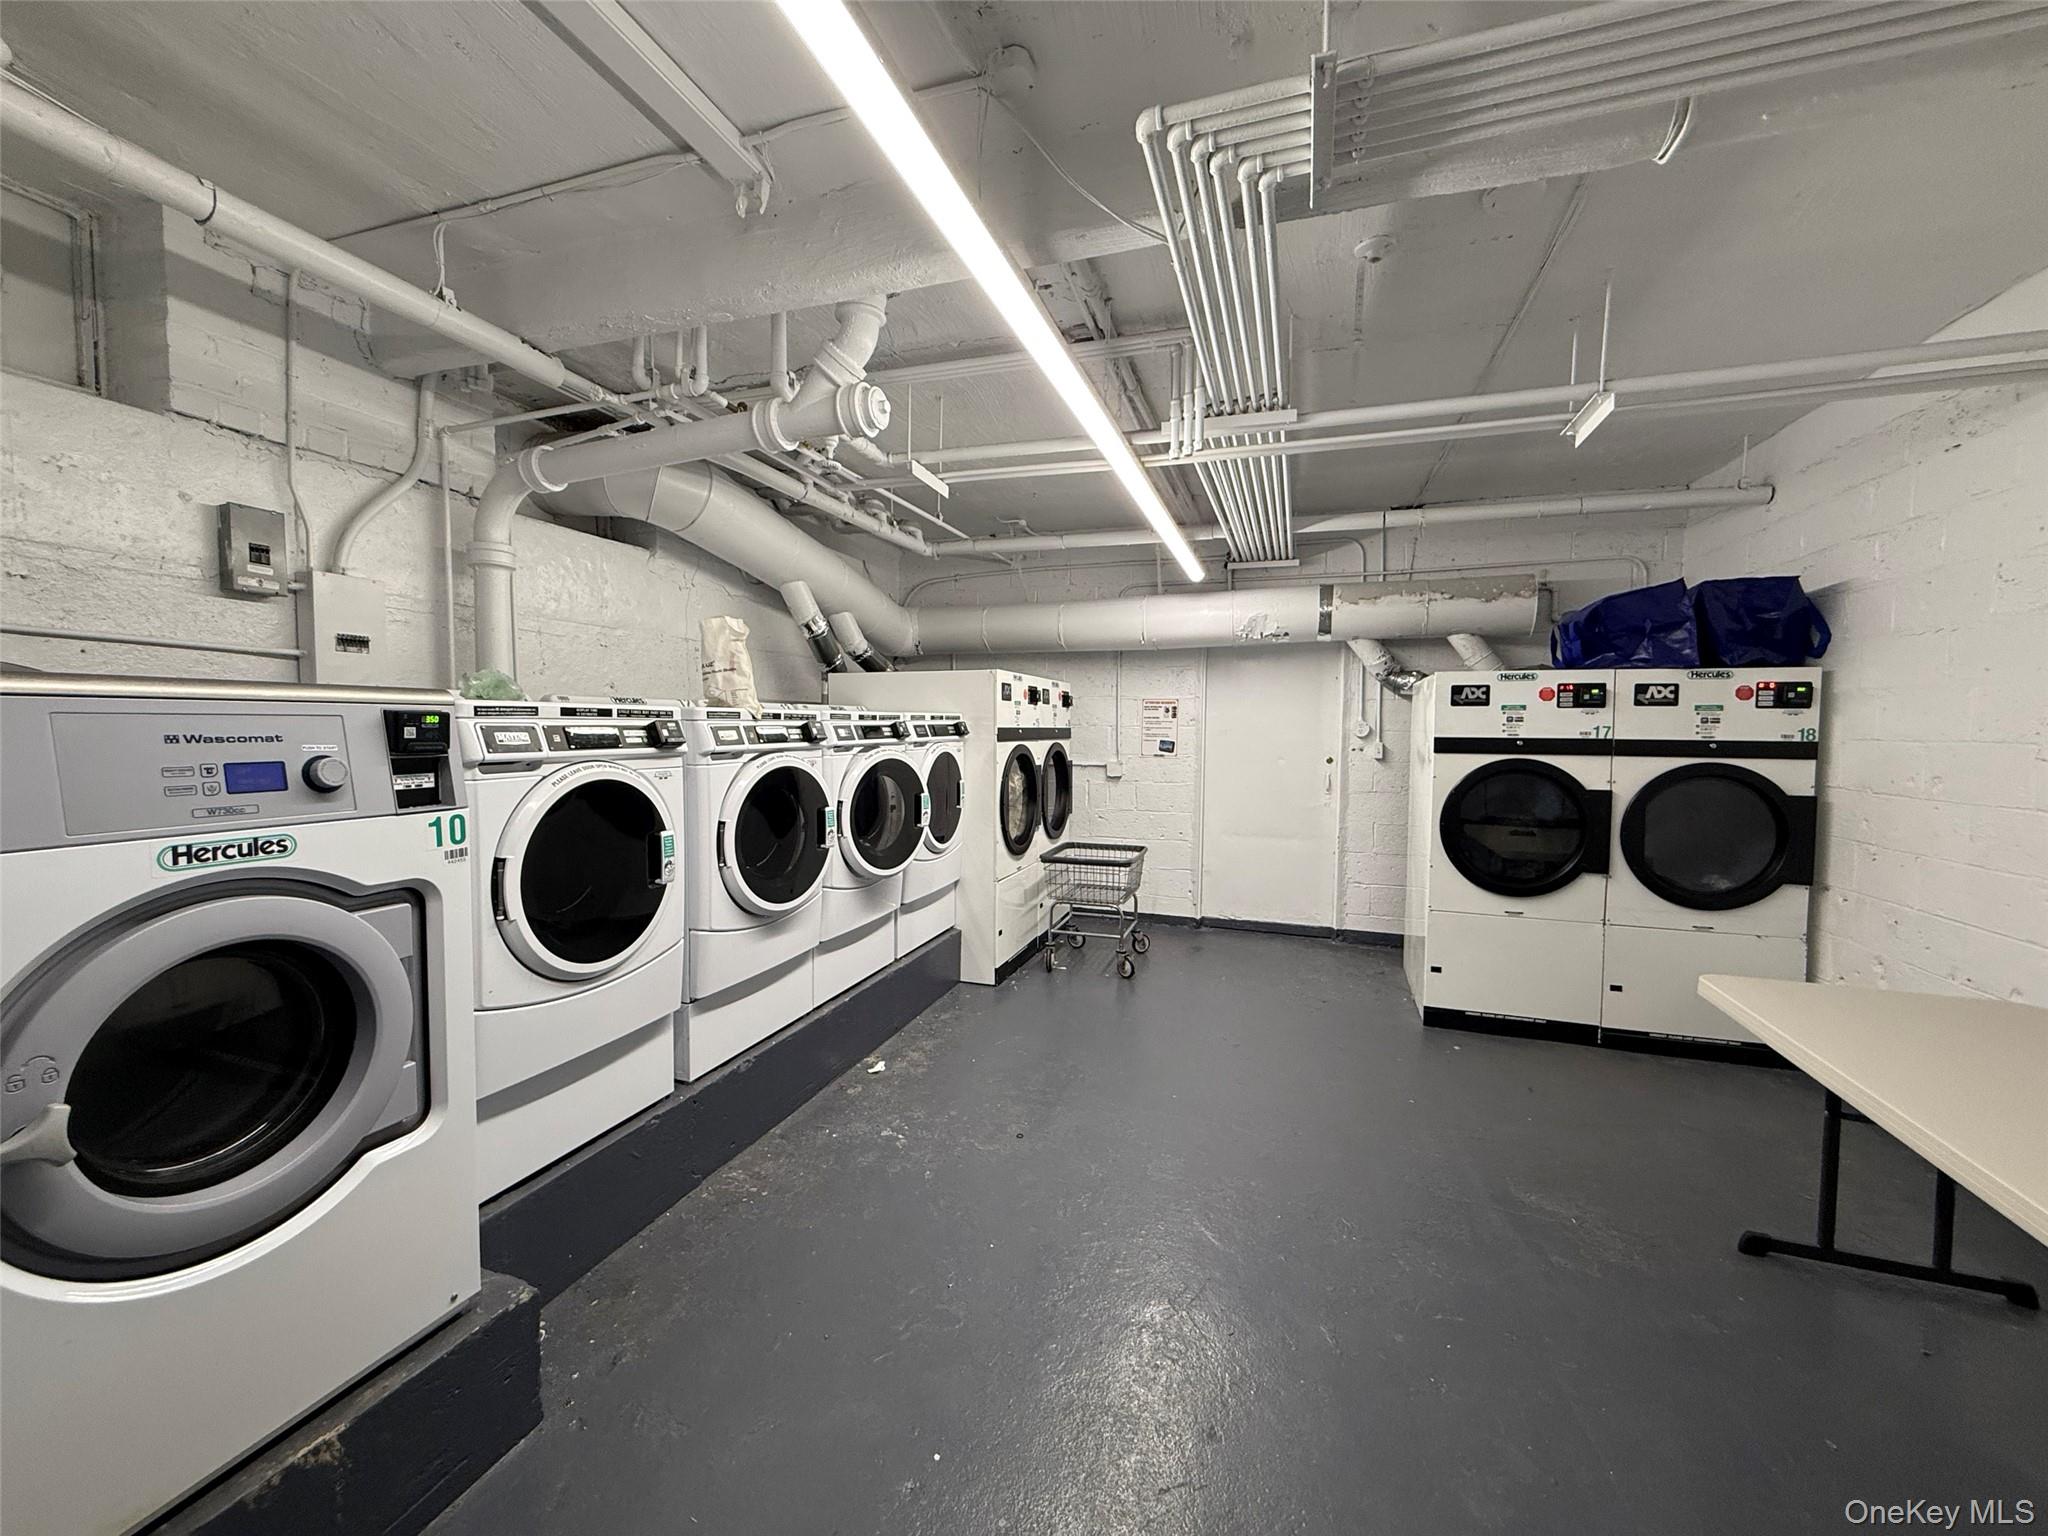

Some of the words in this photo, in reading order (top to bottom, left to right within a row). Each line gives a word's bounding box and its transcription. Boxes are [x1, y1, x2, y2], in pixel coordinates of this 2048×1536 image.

[1500, 673, 1536, 681] Hercules
[1691, 671, 1731, 679] Hercules
[1460, 686, 1487, 699] ADC
[1645, 685, 1675, 699] ADC
[1593, 725, 1612, 739] 17
[1797, 727, 1817, 742] 18
[182, 733, 284, 745] Wascomat
[552, 774, 569, 787] PLEASE
[428, 813, 467, 848] 10
[171, 837, 289, 866] Hercules
